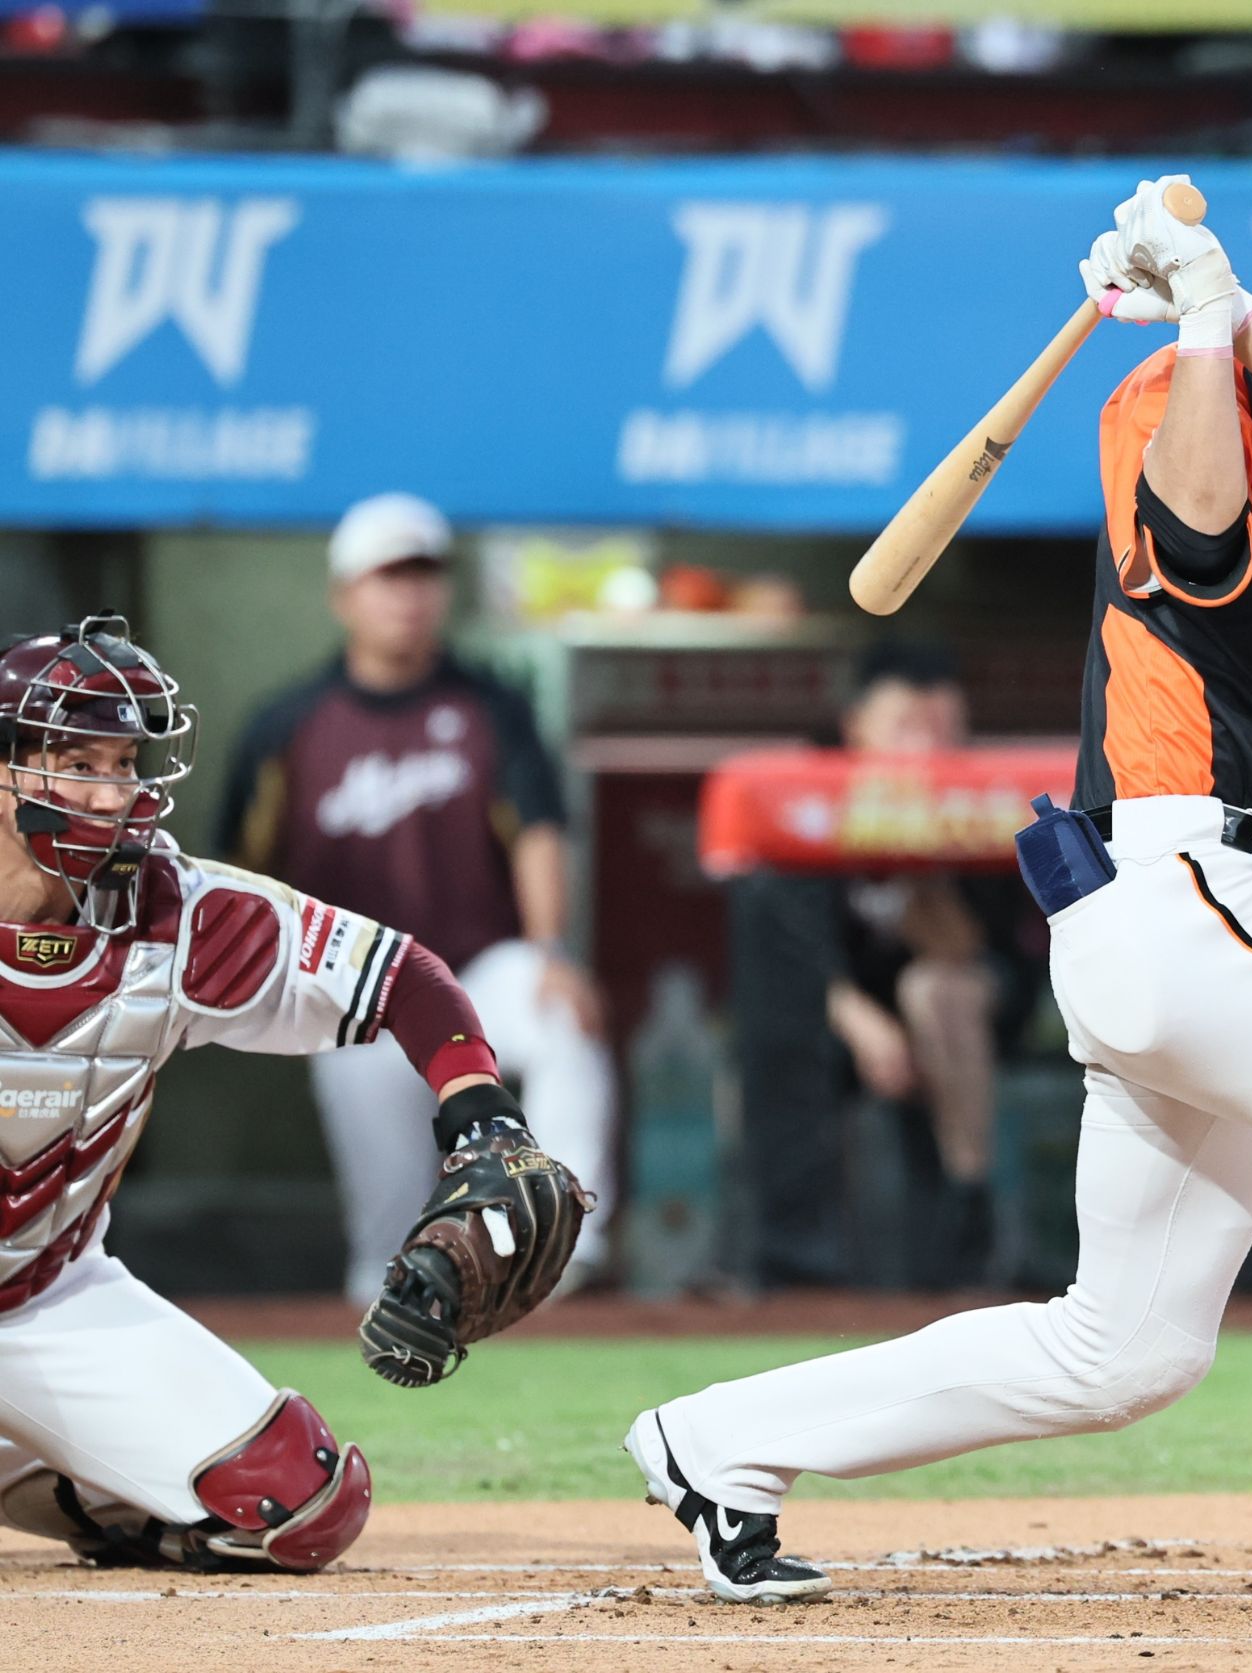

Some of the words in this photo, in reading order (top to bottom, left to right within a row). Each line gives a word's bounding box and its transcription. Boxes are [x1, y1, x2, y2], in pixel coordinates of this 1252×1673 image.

[21, 937, 74, 955] ZETT
[300, 904, 325, 969] JOHNSO
[0, 1082, 83, 1118] gerair
